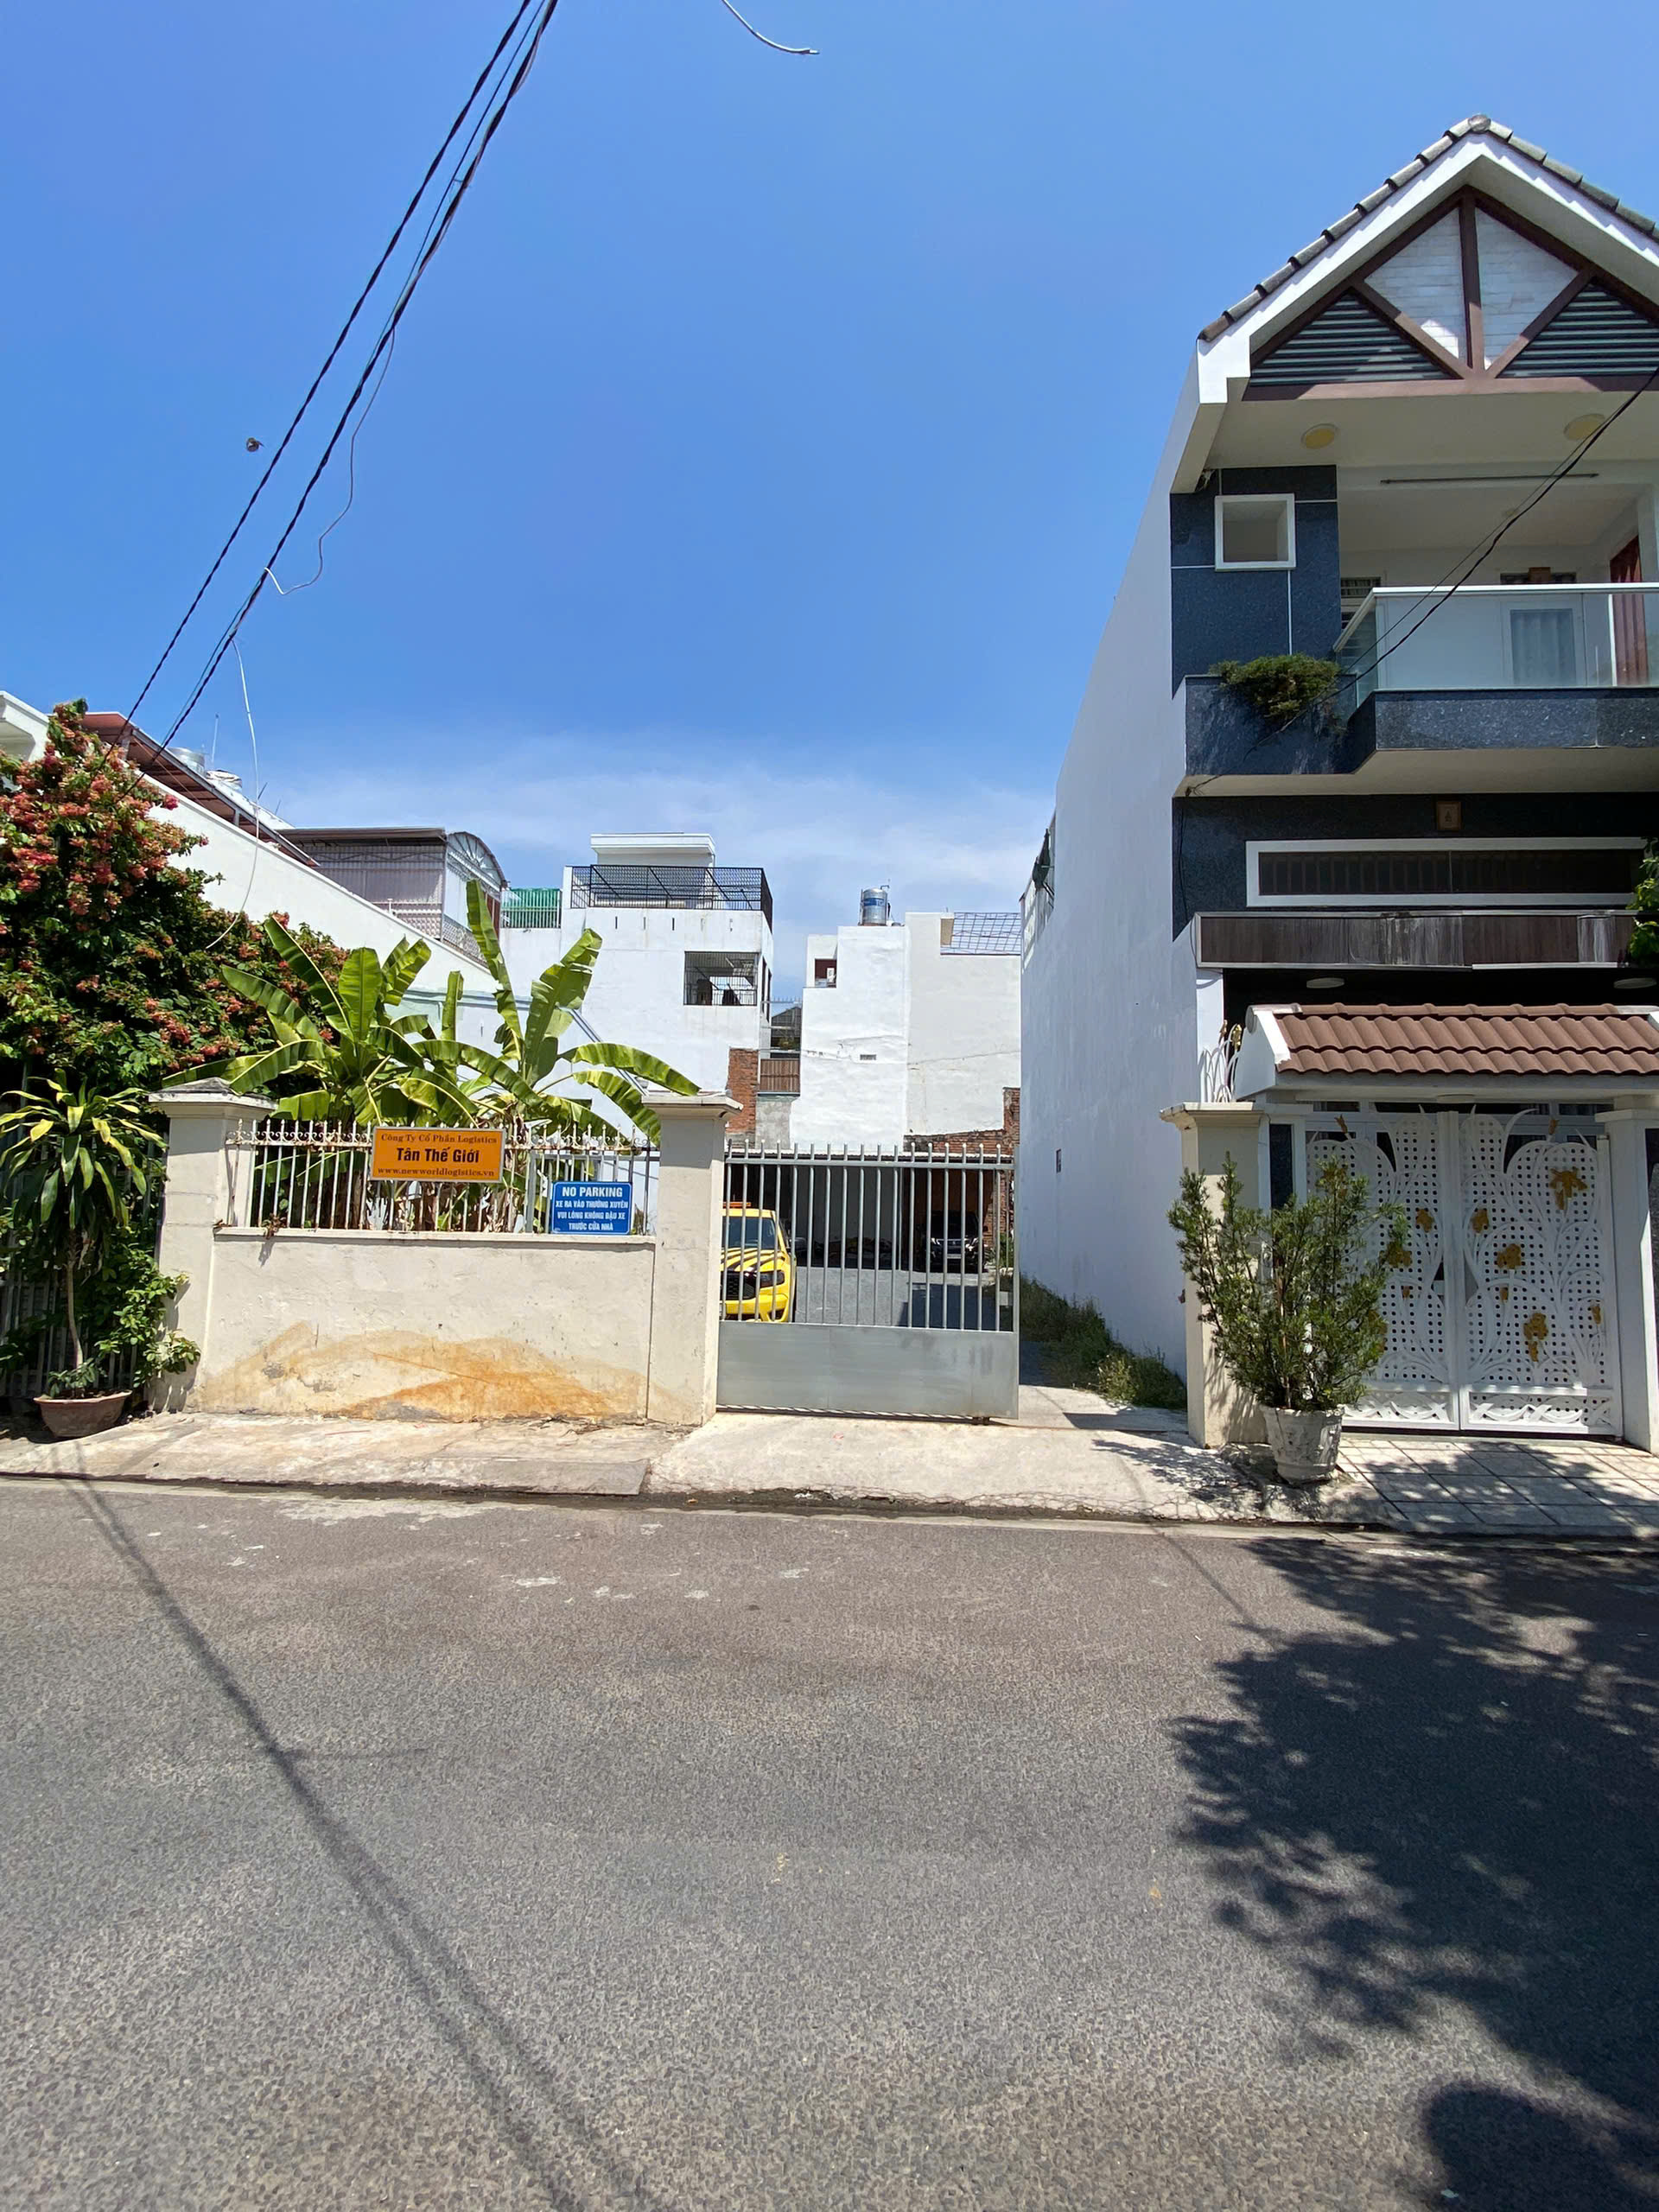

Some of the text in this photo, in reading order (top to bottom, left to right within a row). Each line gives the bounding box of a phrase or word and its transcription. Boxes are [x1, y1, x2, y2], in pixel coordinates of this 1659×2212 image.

[381, 1133, 404, 1142] Công
[406, 1134, 416, 1143] Ty
[457, 1135, 498, 1145] Logistics
[397, 1147, 480, 1163] Tân Thế Giới
[378, 1167, 495, 1178] www.newworldlogistics.vn
[562, 1186, 623, 1198] NO PARKING
[574, 1199, 585, 1208] VÀO
[609, 1199, 629, 1209] XUYÊN
[584, 1211, 604, 1219] KHÔNG
[601, 1222, 613, 1230] NHÀ
